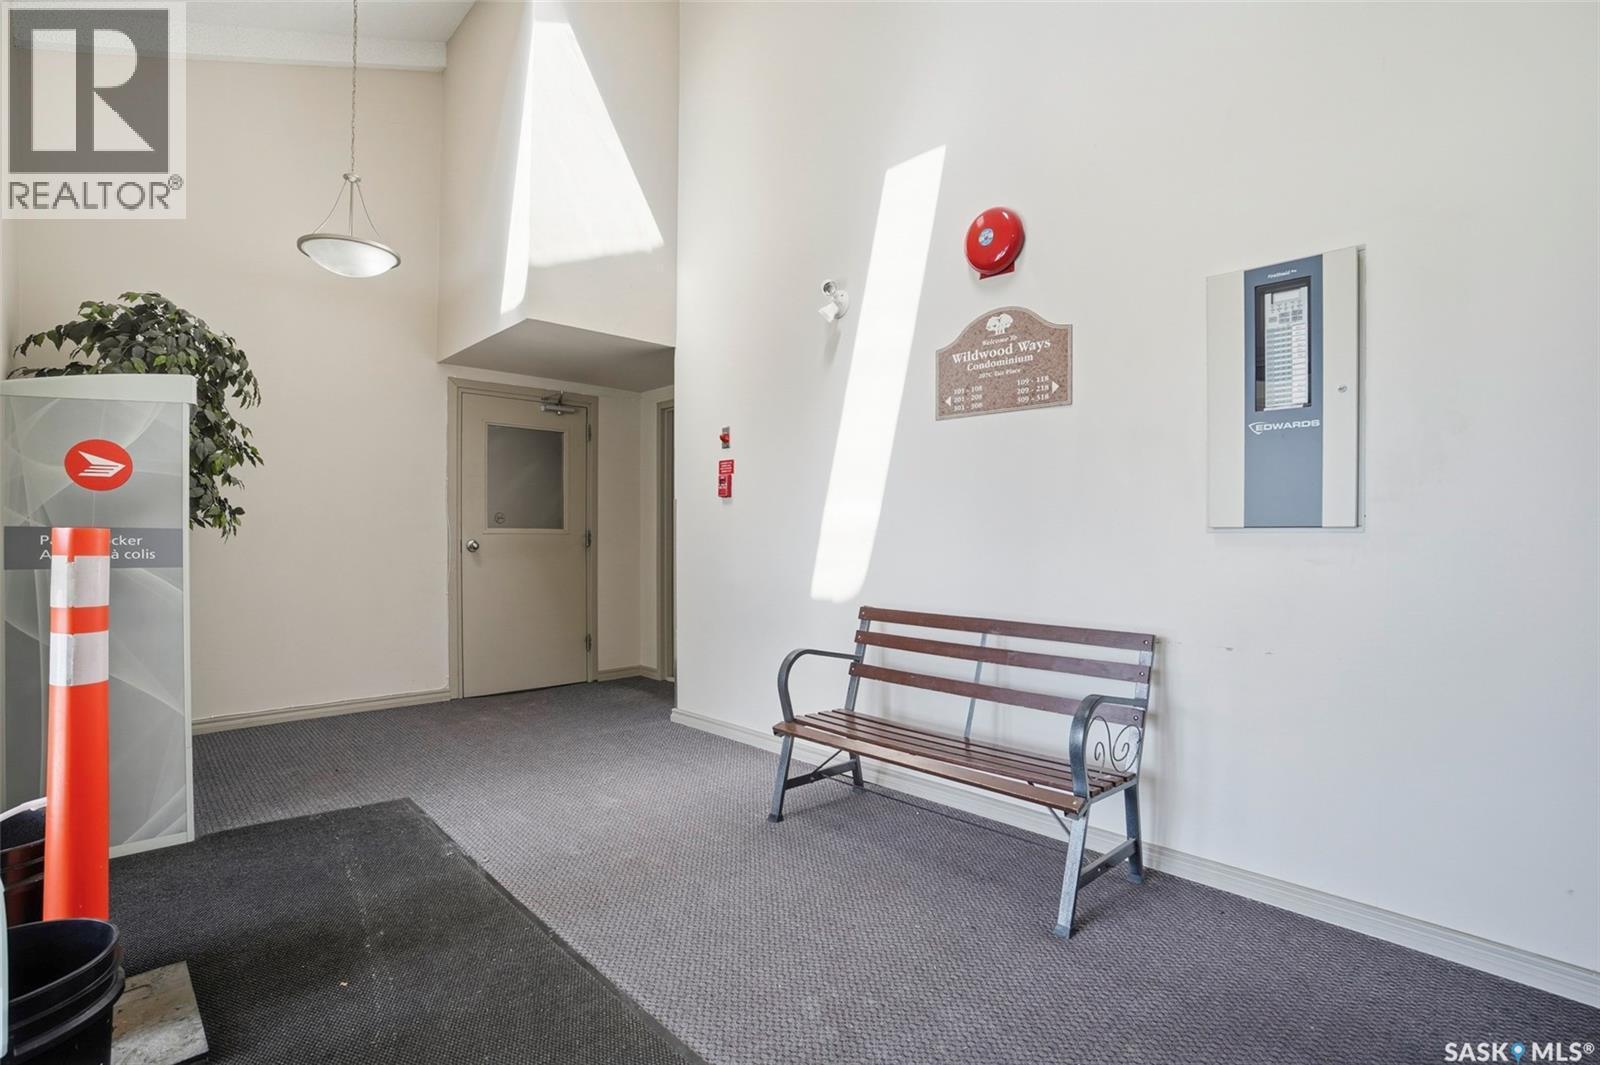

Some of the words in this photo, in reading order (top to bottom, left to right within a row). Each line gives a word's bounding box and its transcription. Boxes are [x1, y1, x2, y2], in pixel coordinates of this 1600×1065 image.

[952, 343, 1013, 364] Wildwood
[1018, 339, 1051, 353] Ways
[967, 354, 1034, 371] Condominium
[1255, 419, 1320, 432] EDWARDS
[111, 534, 143, 546] cker
[111, 548, 119, 560] à
[124, 548, 156, 560] colis
